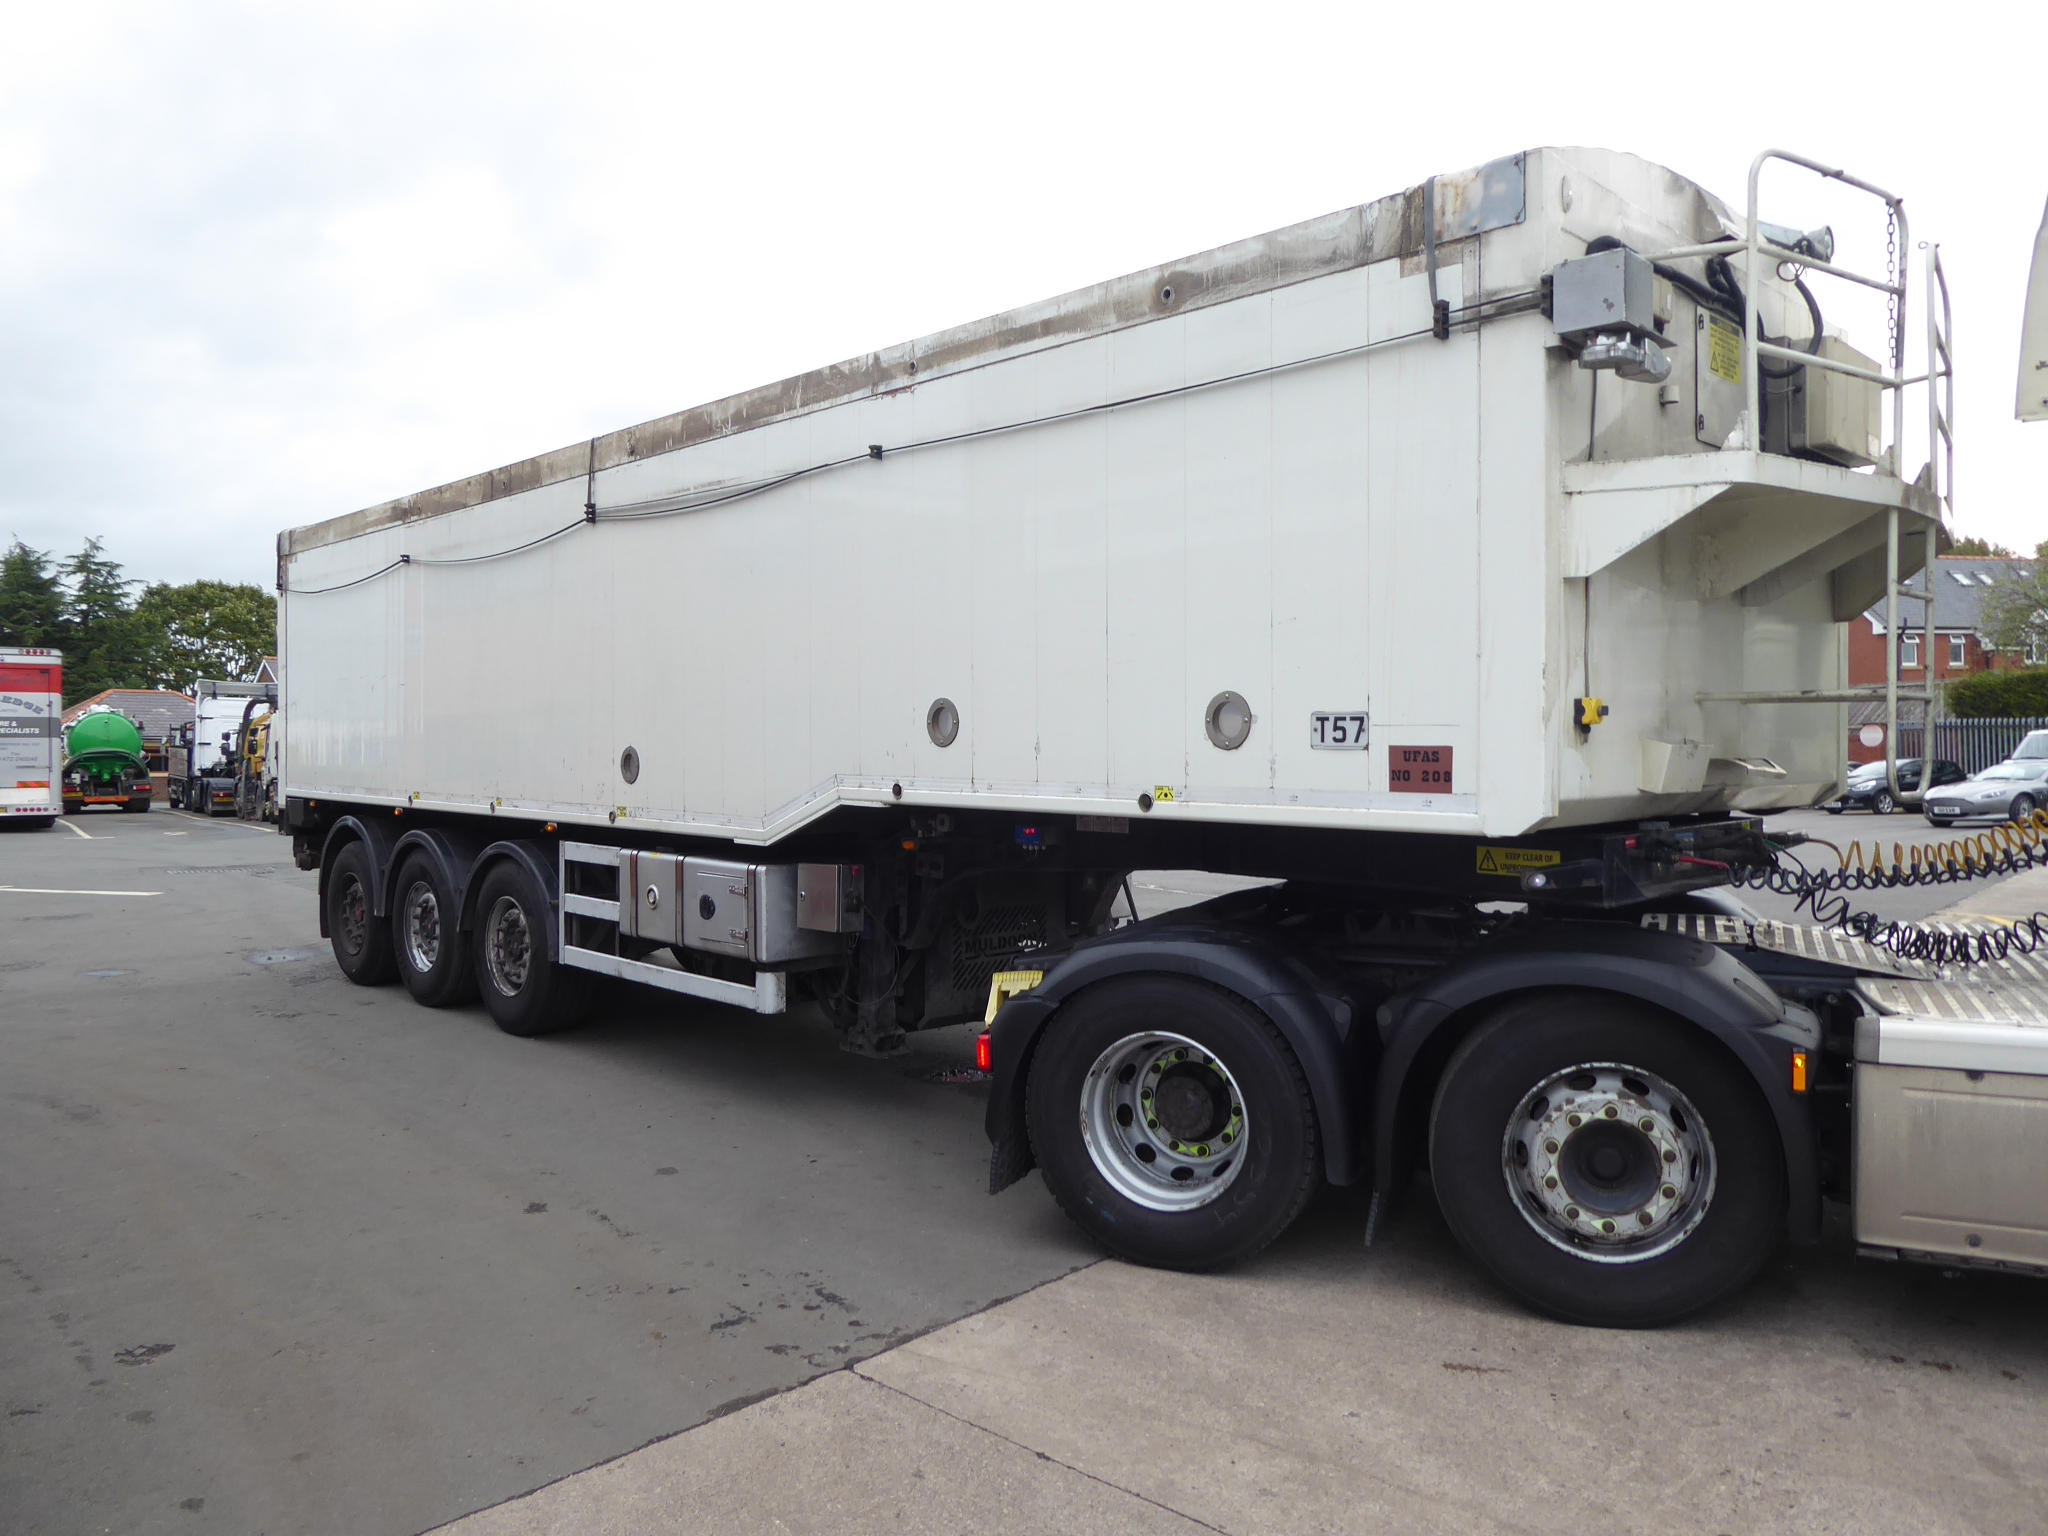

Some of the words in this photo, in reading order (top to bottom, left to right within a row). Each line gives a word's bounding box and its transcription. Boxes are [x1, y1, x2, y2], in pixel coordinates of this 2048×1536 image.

[1315, 716, 1365, 744] T57
[1402, 750, 1440, 763] UFAS
[1391, 769, 1411, 782] NO
[1504, 852, 1521, 861] KEEP
[1522, 853, 1543, 863] CLEAR
[1544, 855, 1554, 863] OF
[964, 932, 1038, 954] MULDOON
